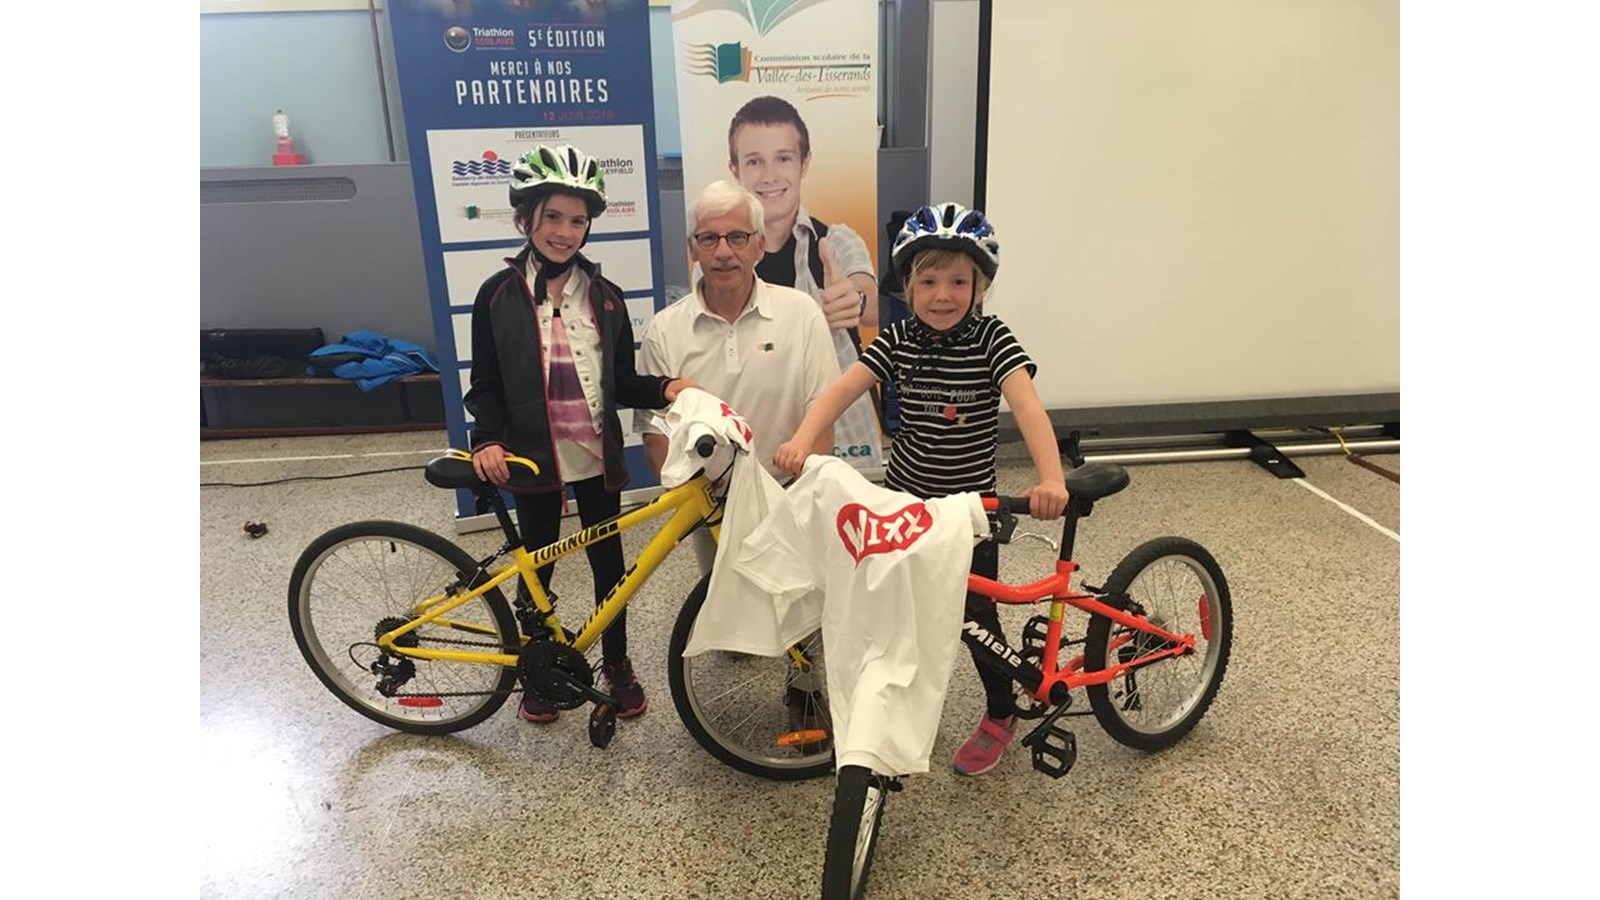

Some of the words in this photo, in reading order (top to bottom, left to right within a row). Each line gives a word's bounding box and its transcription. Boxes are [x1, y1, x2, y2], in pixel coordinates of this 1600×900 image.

[472, 27, 514, 37] Triathlon
[547, 26, 606, 48] ÉDITION
[754, 54, 810, 62] Commission
[812, 53, 846, 61] scolaire
[849, 52, 860, 61] de
[863, 52, 871, 60] la
[490, 61, 529, 76] MERCI
[534, 58, 543, 75] À
[547, 61, 572, 75] NOS
[455, 78, 609, 106] PARTENAIRES
[597, 158, 633, 168] iathlon
[832, 442, 872, 458] c.ca
[963, 620, 1022, 668] Miele
